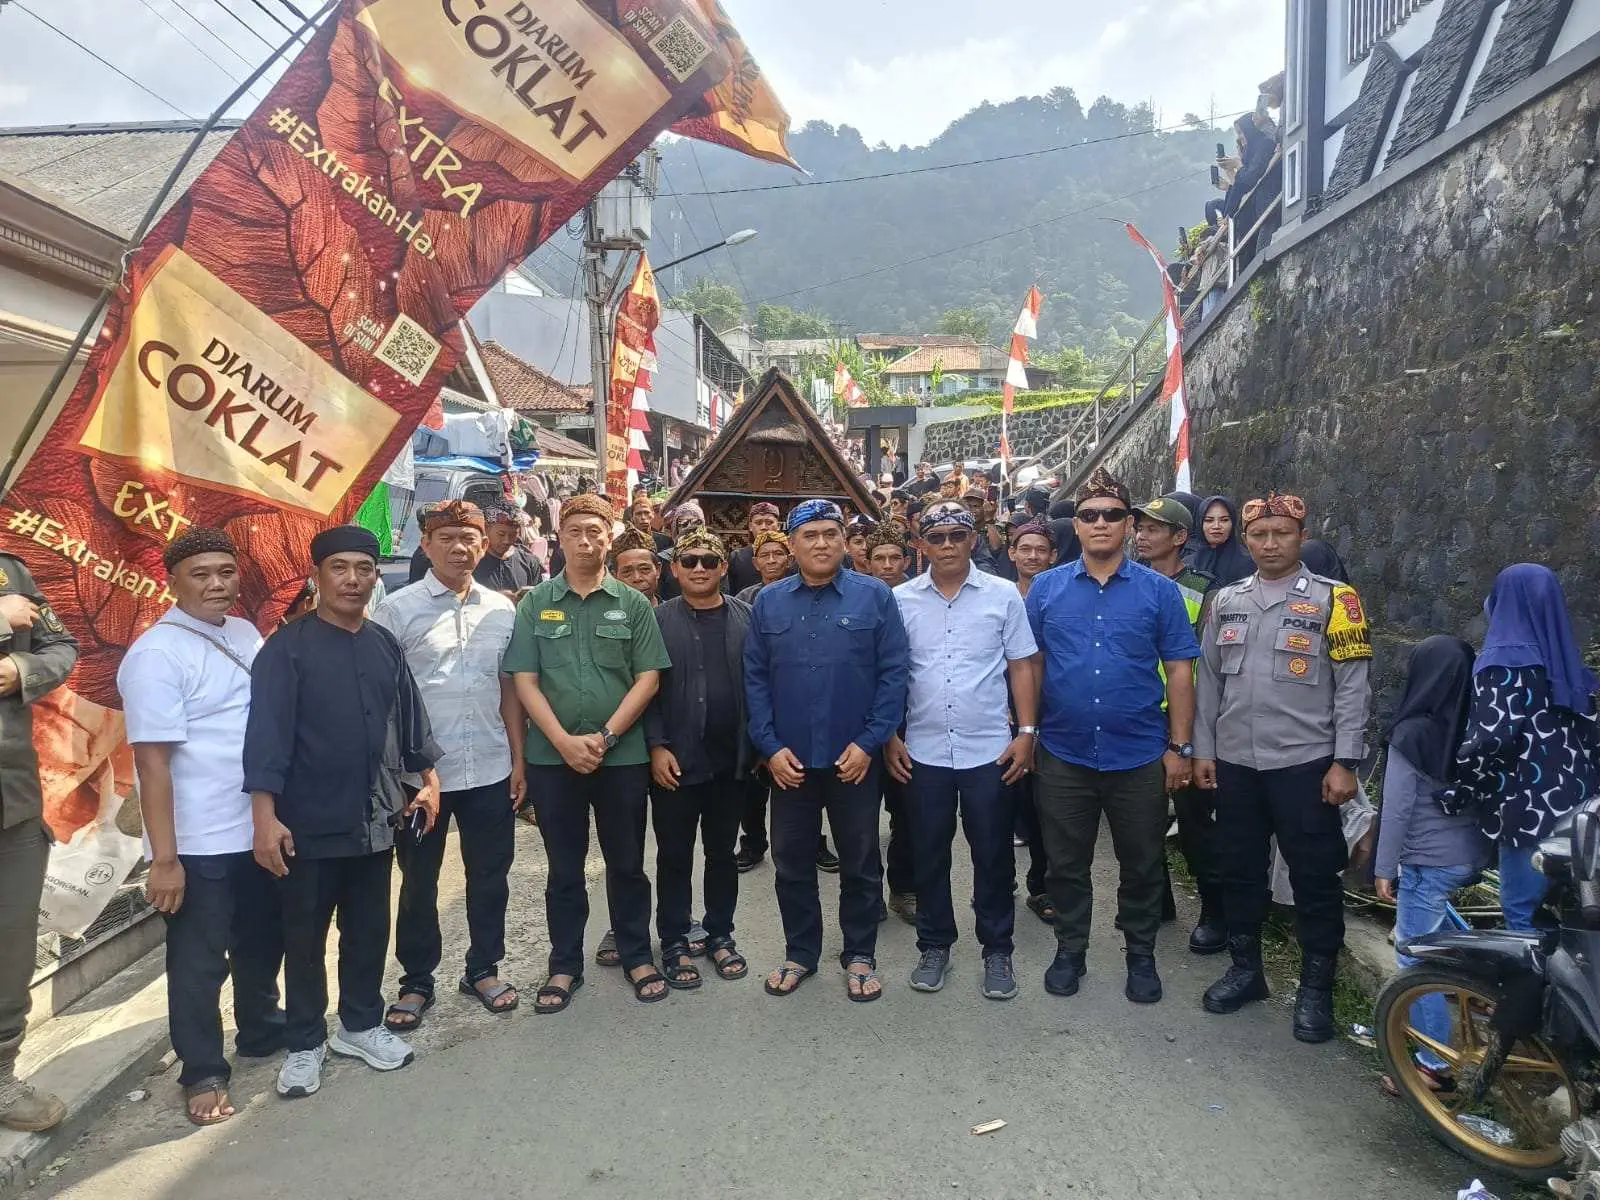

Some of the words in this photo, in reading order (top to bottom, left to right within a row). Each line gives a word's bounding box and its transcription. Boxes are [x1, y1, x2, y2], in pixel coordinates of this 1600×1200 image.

[624, 9, 638, 22] DI
[632, 19, 652, 39] SINI
[639, 6, 662, 30] SCAN
[268, 107, 397, 226] #Extrakan
[378, 77, 483, 218] EXTRA
[343, 322, 356, 337] DI
[353, 331, 376, 351] SINI
[357, 315, 384, 339] SCAN
[138, 339, 343, 492] COKLAT
[200, 337, 319, 435] DJARUM
[7, 509, 157, 597] #Extrakan
[1283, 618, 1321, 632] POLRI
